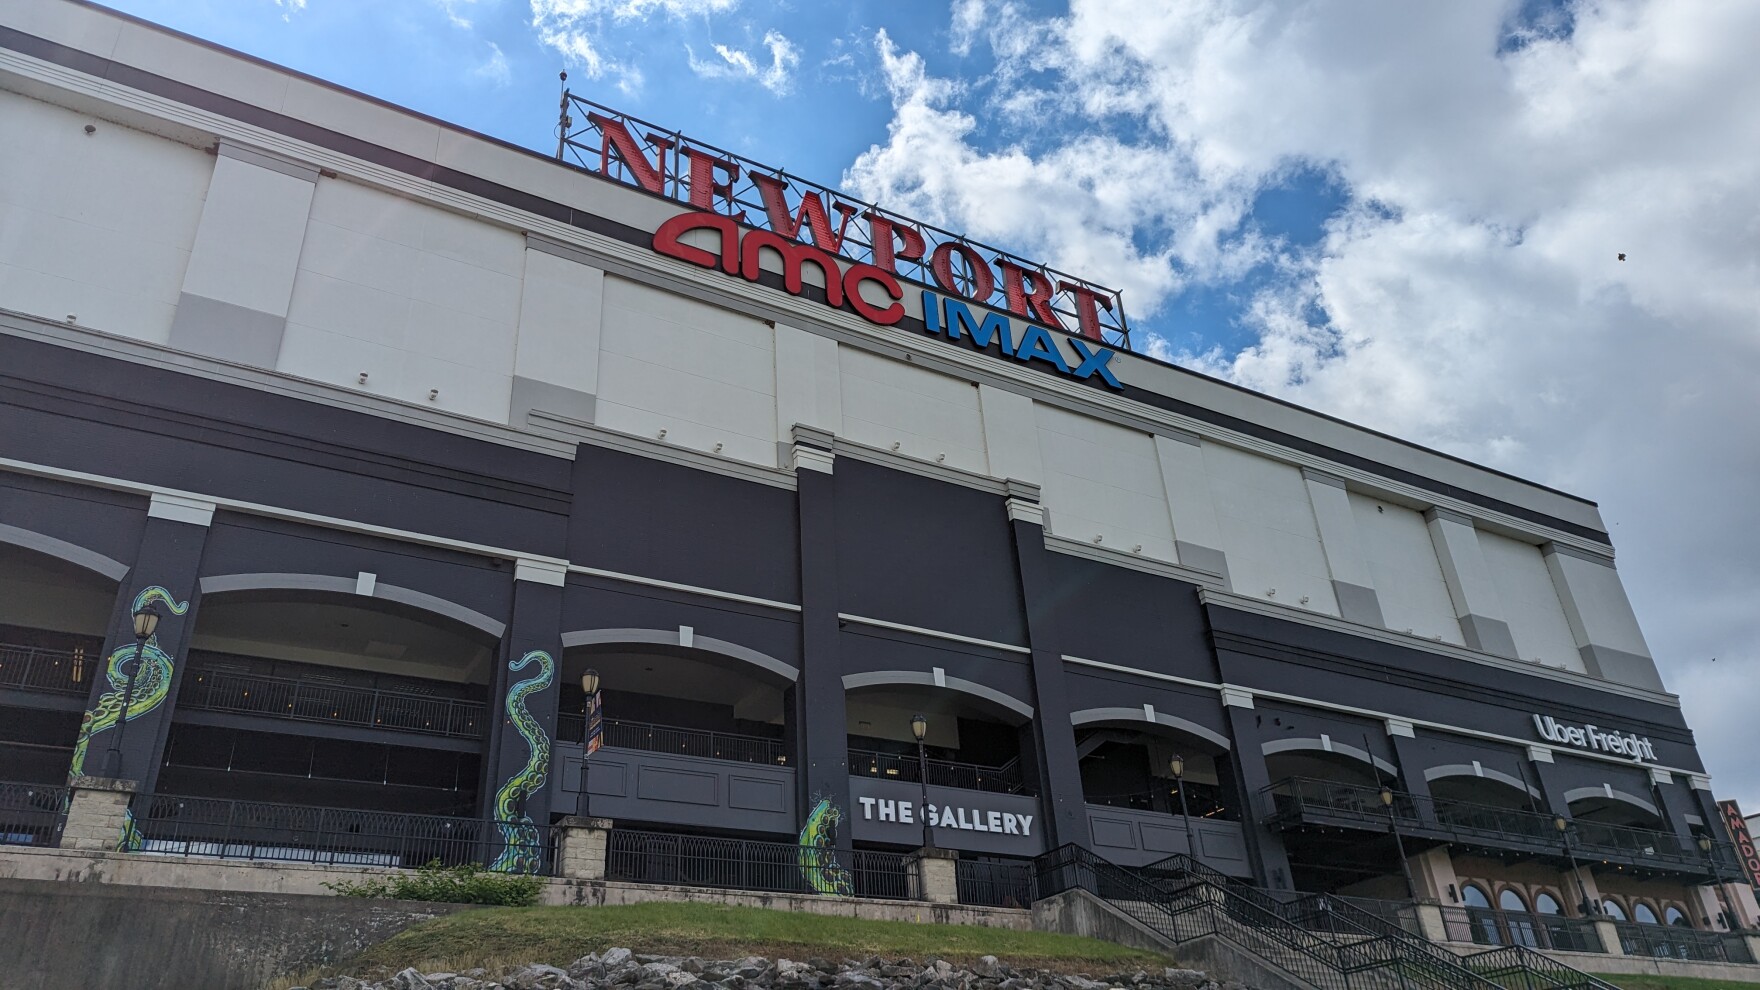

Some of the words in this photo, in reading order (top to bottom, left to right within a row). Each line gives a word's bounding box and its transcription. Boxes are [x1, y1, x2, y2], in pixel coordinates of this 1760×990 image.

[588, 111, 1113, 341] NEWPORT
[921, 290, 1125, 391] IMAX
[1532, 713, 1587, 747] Uber
[1584, 724, 1658, 763] Freight
[859, 797, 914, 824] THE
[920, 803, 1033, 836] GALLERY
